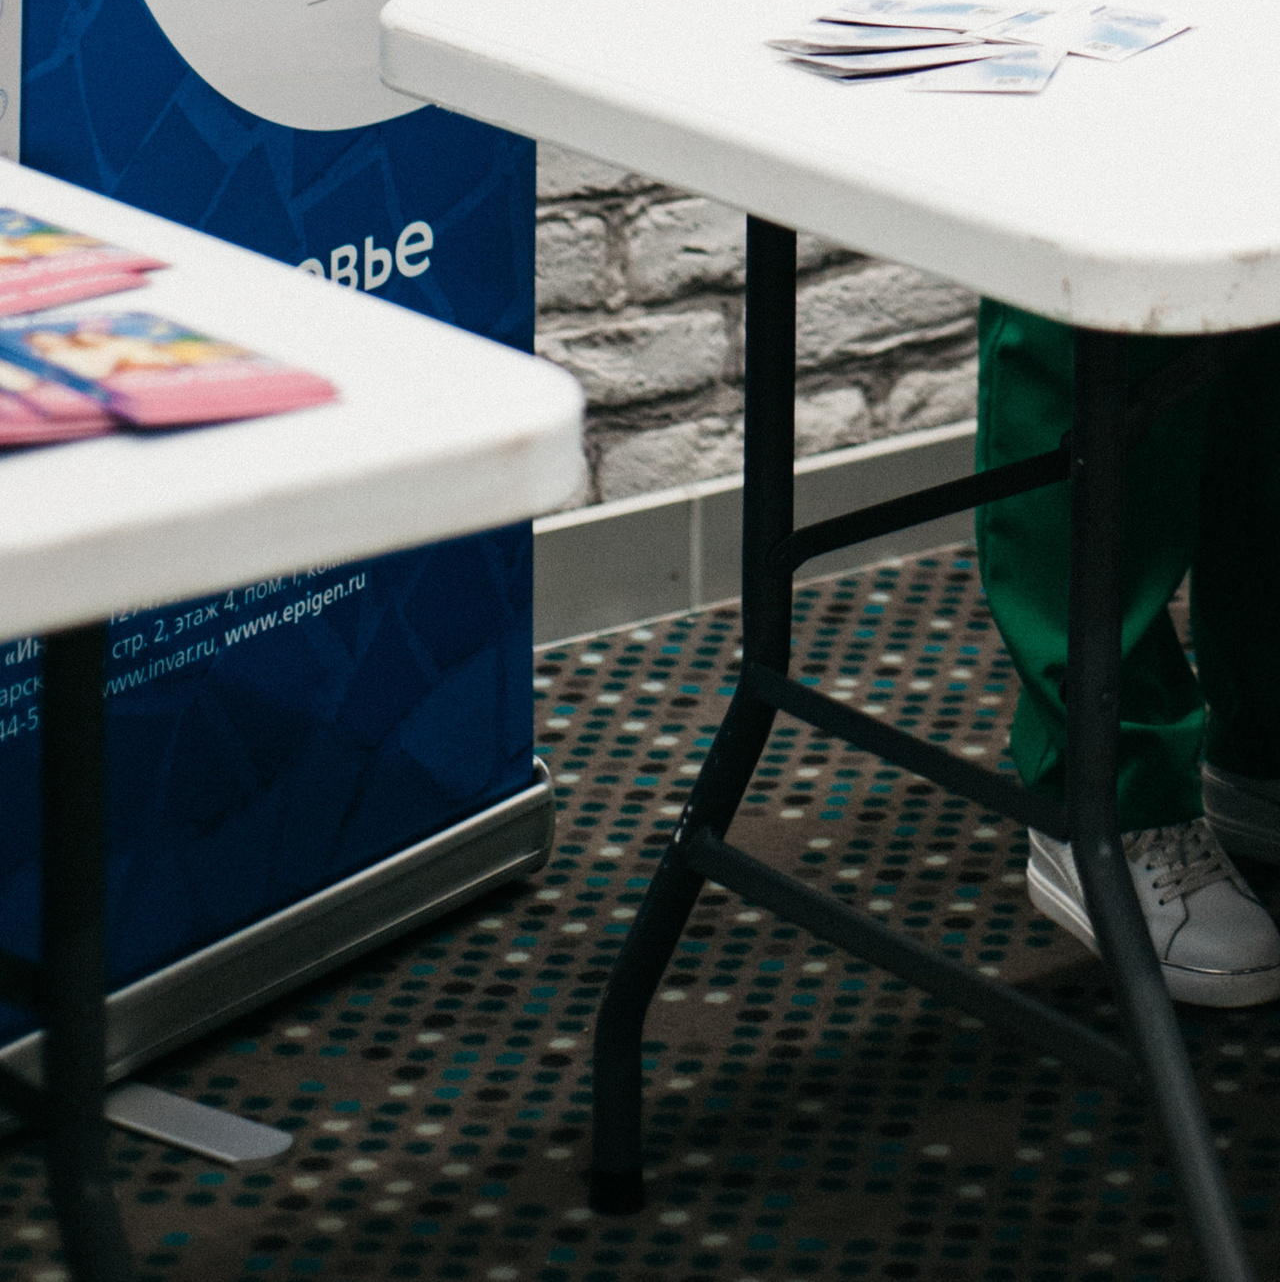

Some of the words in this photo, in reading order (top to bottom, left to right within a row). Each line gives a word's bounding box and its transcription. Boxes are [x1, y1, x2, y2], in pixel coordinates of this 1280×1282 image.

[112, 633, 148, 659] стр.
[154, 619, 170, 643] 2,
[174, 601, 219, 635] этаж
[224, 571, 366, 647] www.epigen.ru
